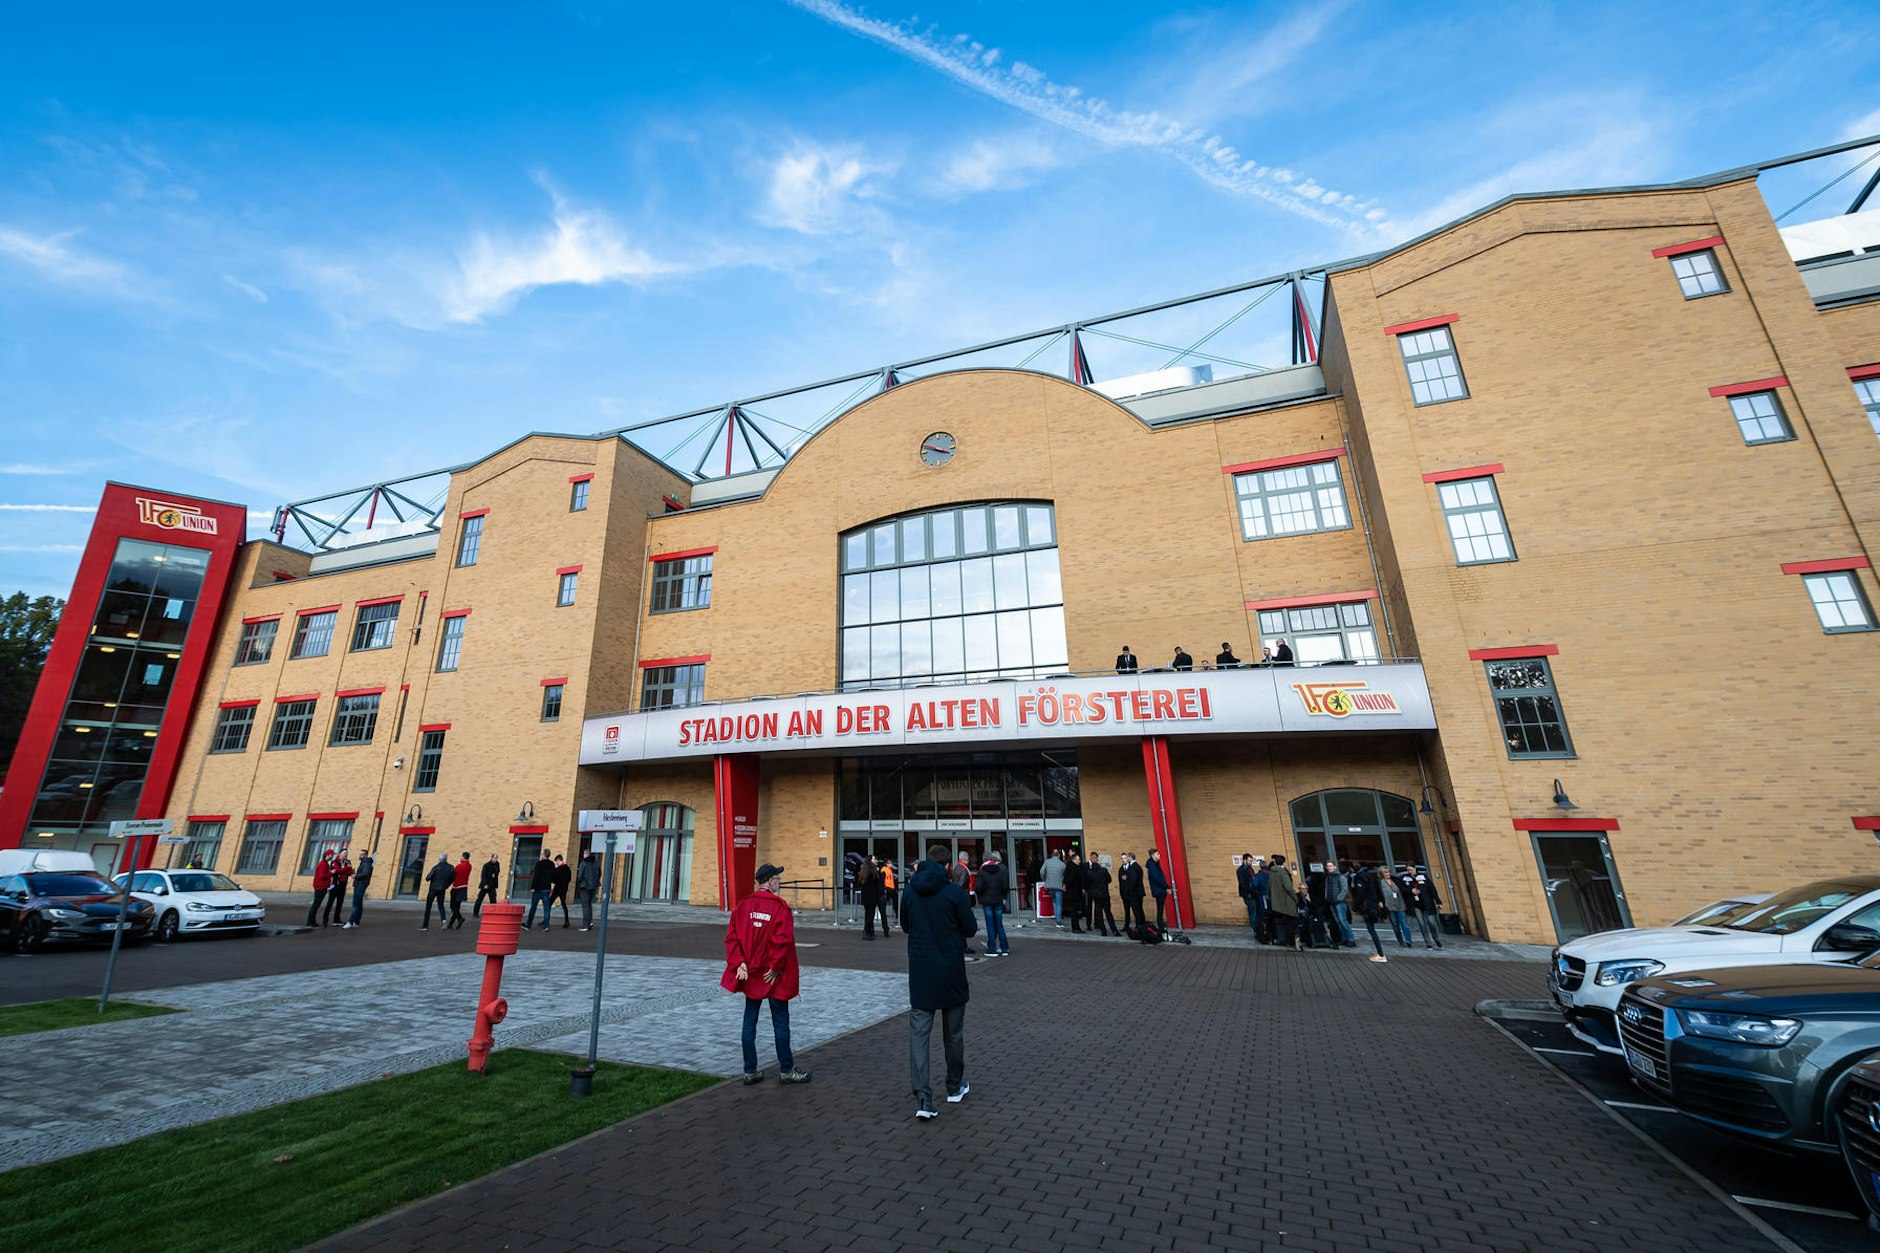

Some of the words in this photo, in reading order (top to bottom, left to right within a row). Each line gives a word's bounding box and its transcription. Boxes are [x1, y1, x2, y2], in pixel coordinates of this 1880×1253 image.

[182, 515, 215, 532] UNION
[1351, 693, 1397, 711] UNION
[679, 712, 779, 745] STADION
[786, 709, 823, 737] AN
[835, 704, 891, 735] DER
[906, 697, 1002, 731] ALTEN
[1018, 686, 1213, 725] FÖRSTEREI
